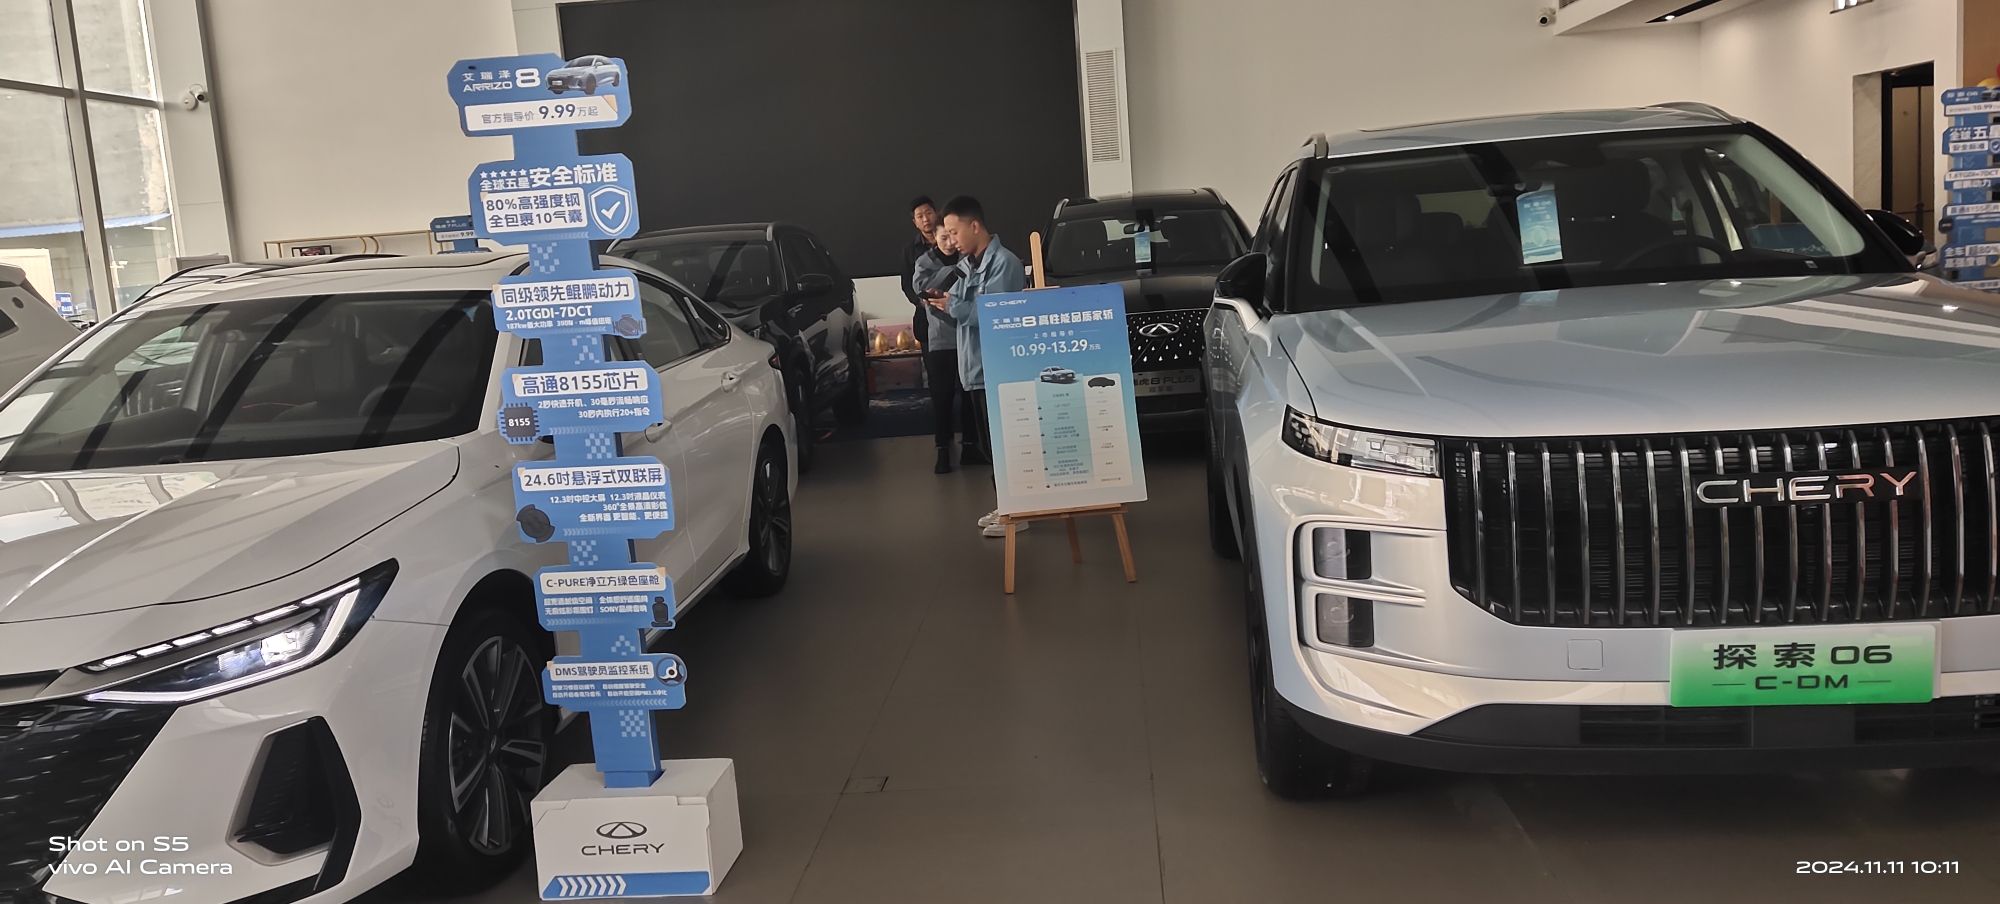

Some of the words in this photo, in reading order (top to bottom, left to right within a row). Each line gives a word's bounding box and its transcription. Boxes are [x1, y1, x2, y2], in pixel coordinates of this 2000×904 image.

[462, 70, 511, 82] 艾瑞泽
[463, 82, 512, 93] ARRIZO
[515, 68, 541, 88] 8
[480, 177, 530, 191] 全球五星
[529, 163, 618, 188] 安全标准
[486, 193, 581, 211] 80%高强度钢
[488, 210, 584, 228] 全包裹10气囊
[502, 282, 630, 304] 同级领先鲲鹏动力
[505, 305, 593, 321] 2.0TGDI-7DCT
[521, 371, 639, 395] 高通8155芯片
[508, 418, 531, 427] 8155
[525, 468, 663, 487] 24.6吋悬浮式双联屏
[1697, 471, 1917, 503] CHERY
[546, 574, 659, 588] C-PURE净立方绿色座舱
[555, 664, 649, 677] DMS驾驶员监控系统
[1755, 674, 1849, 690] C-DM
[581, 843, 665, 856] CHERY
